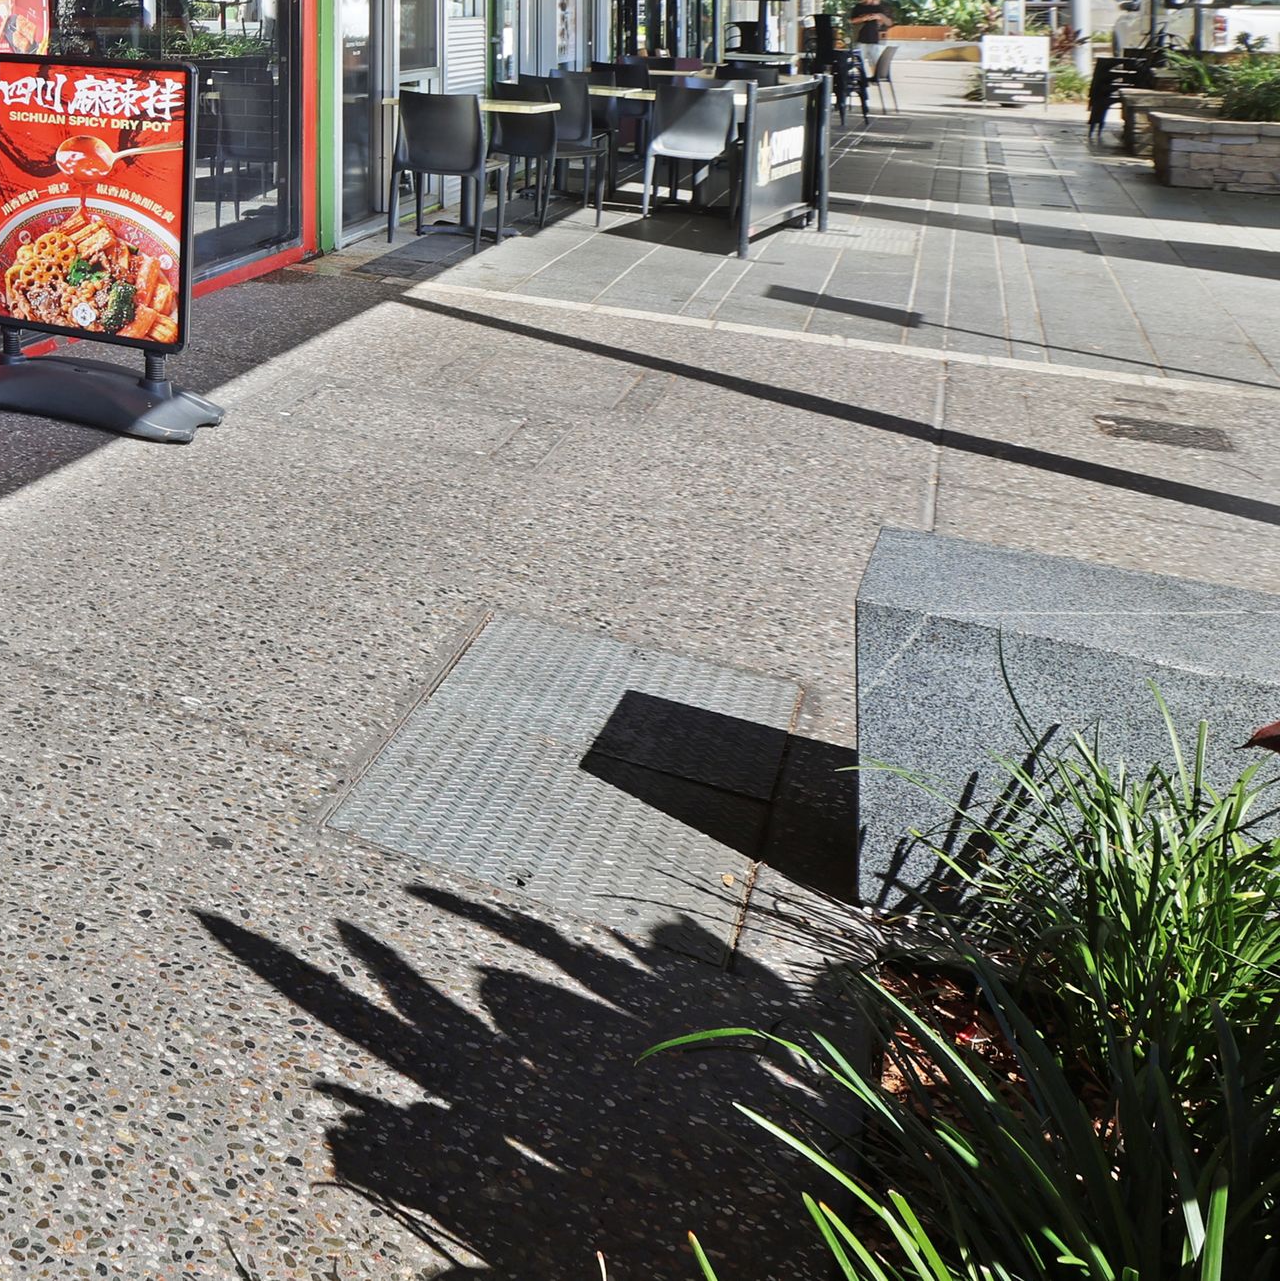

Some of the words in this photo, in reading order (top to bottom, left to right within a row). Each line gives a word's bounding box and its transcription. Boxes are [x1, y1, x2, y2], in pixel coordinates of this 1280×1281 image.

[9, 111, 66, 125] SICHUAN
[68, 115, 108, 128] SPICY
[111, 119, 139, 130] DRY
[142, 121, 171, 132] POT
